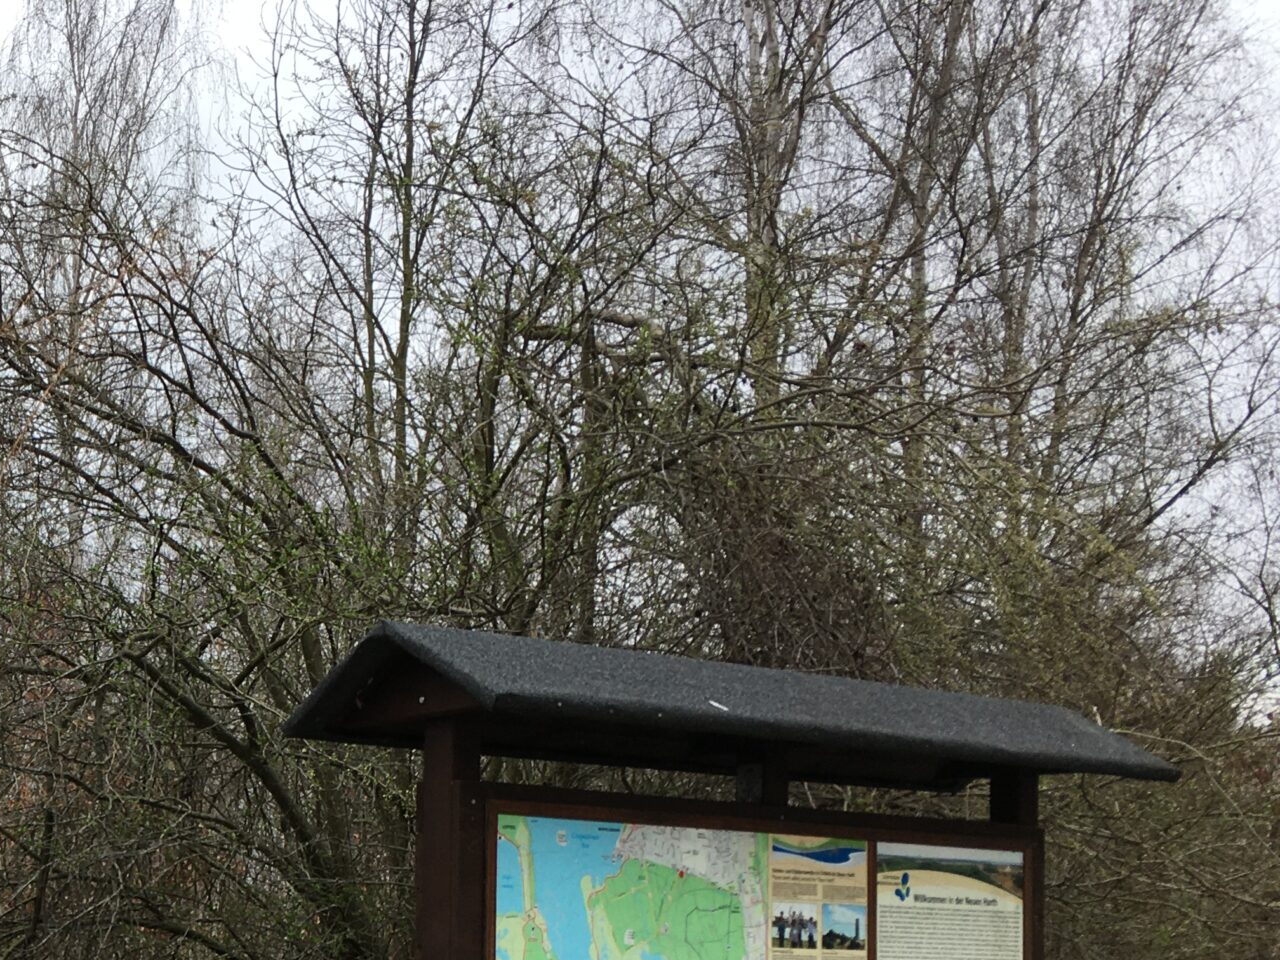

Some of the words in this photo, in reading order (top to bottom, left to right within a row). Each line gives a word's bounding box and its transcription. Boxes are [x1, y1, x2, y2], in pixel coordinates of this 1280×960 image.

[914, 894, 946, 904] Willkommen
[955, 896, 963, 905] der
[965, 896, 982, 905] Neuen
